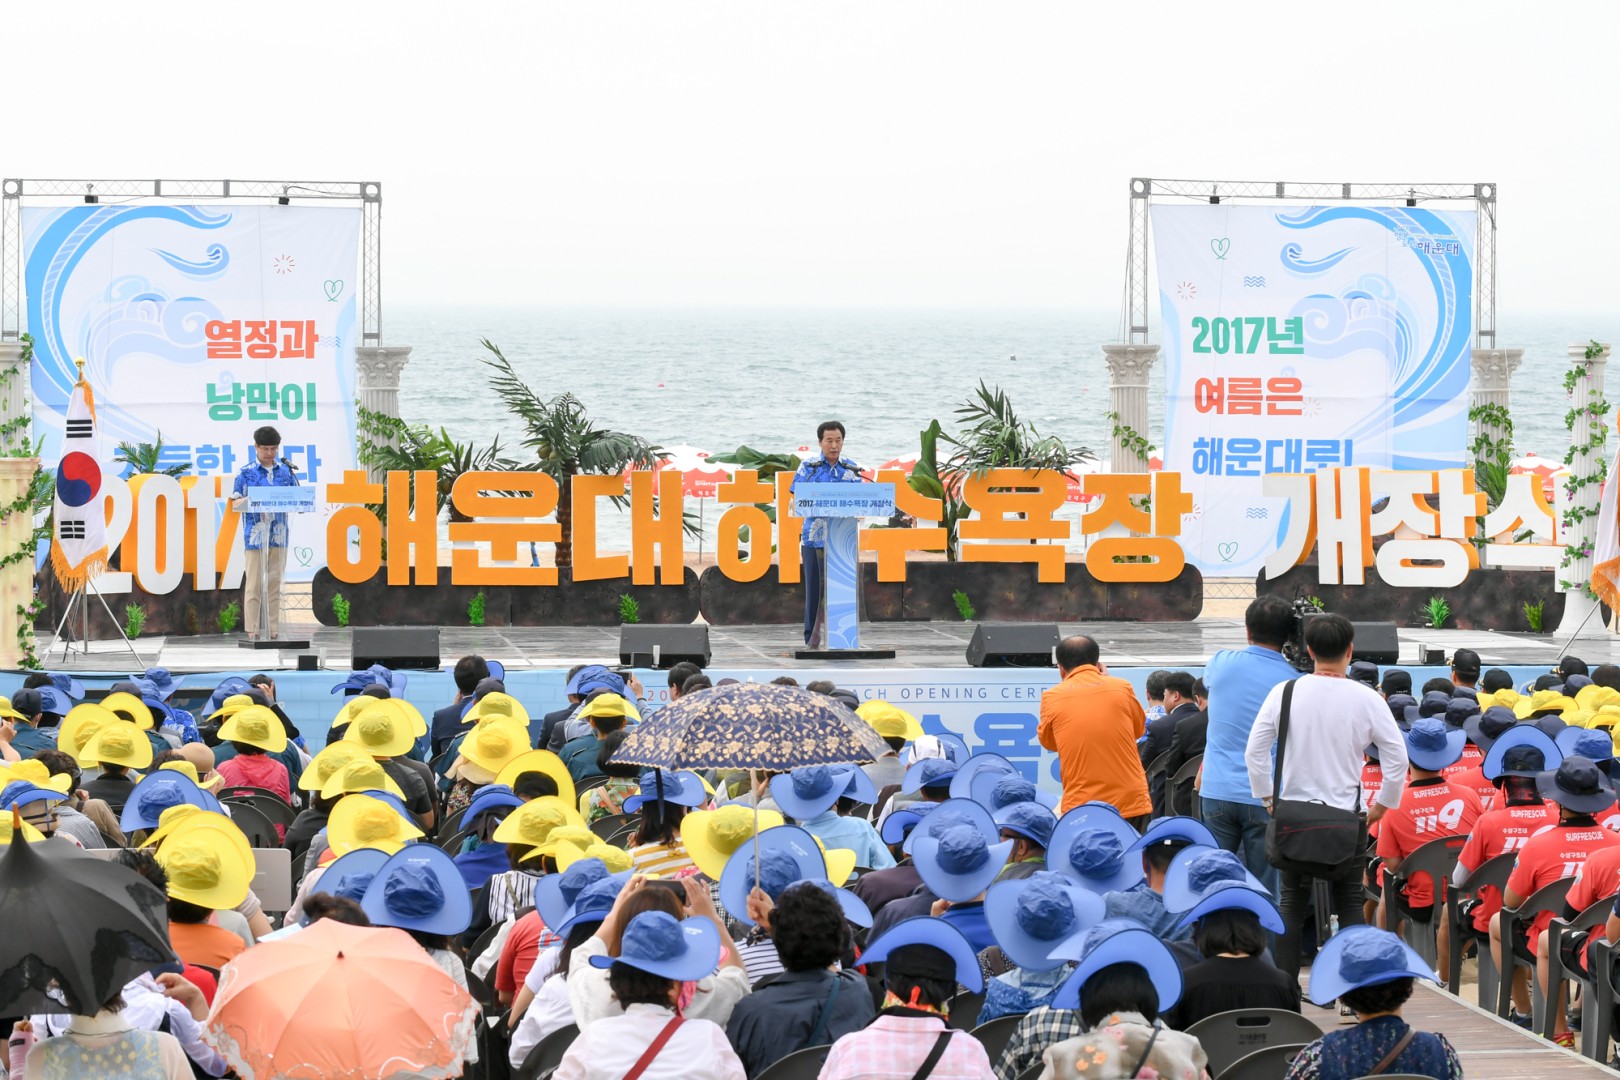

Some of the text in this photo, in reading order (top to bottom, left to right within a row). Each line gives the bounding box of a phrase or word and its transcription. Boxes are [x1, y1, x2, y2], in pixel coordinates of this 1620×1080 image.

[1418, 241, 1459, 256] 해운대
[205, 320, 319, 359] 열정과
[1191, 316, 1304, 354] 2017년
[206, 382, 317, 421] 낭만이
[1195, 377, 1303, 415] 여름은
[326, 470, 684, 586] 해운대
[716, 467, 1193, 583] 해수욕장
[1263, 467, 1567, 593] 개장식
[648, 687, 1048, 701] 20 ACH OPENING CER
[1413, 786, 1450, 799] SURFRESCUE
[1414, 799, 1465, 834] 119
[1510, 809, 1547, 819] SURFRESCUE
[1565, 831, 1604, 842] SURFRESCUE
[1560, 861, 1586, 878] 11
